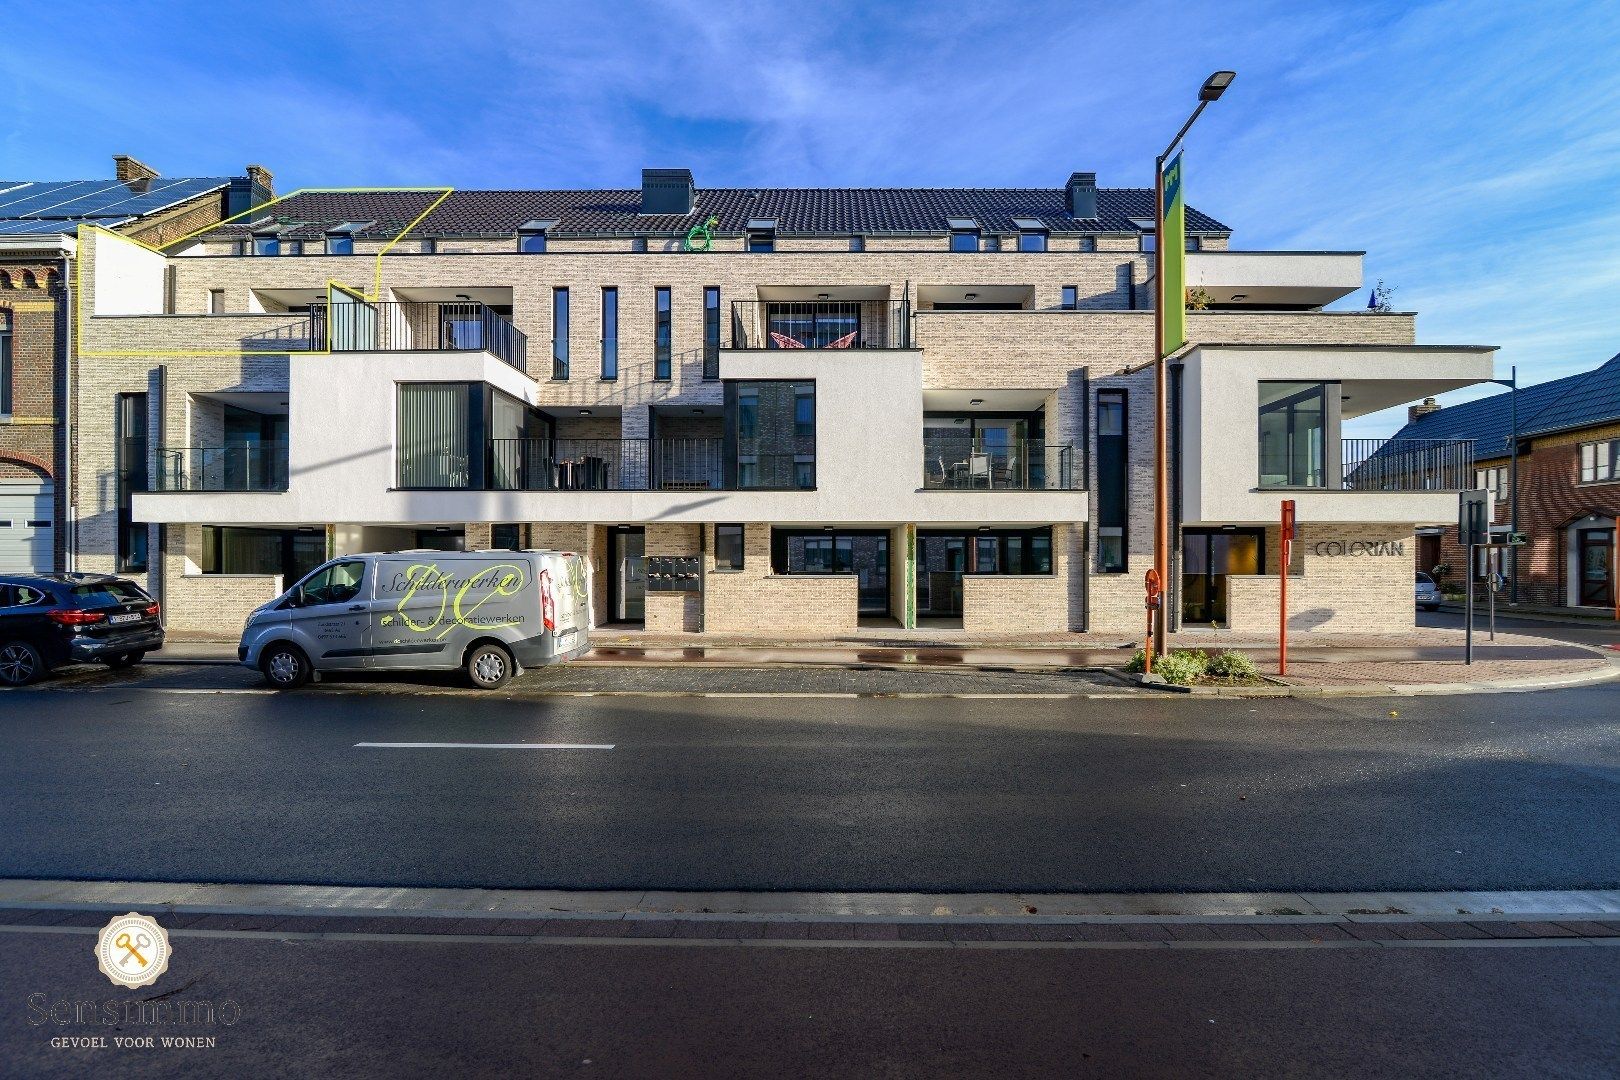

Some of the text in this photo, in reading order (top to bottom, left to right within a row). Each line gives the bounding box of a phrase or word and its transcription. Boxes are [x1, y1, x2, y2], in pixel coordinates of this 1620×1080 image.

[381, 569, 521, 592] Schilderwerken
[382, 613, 525, 628] schilder- & decoratiewerken
